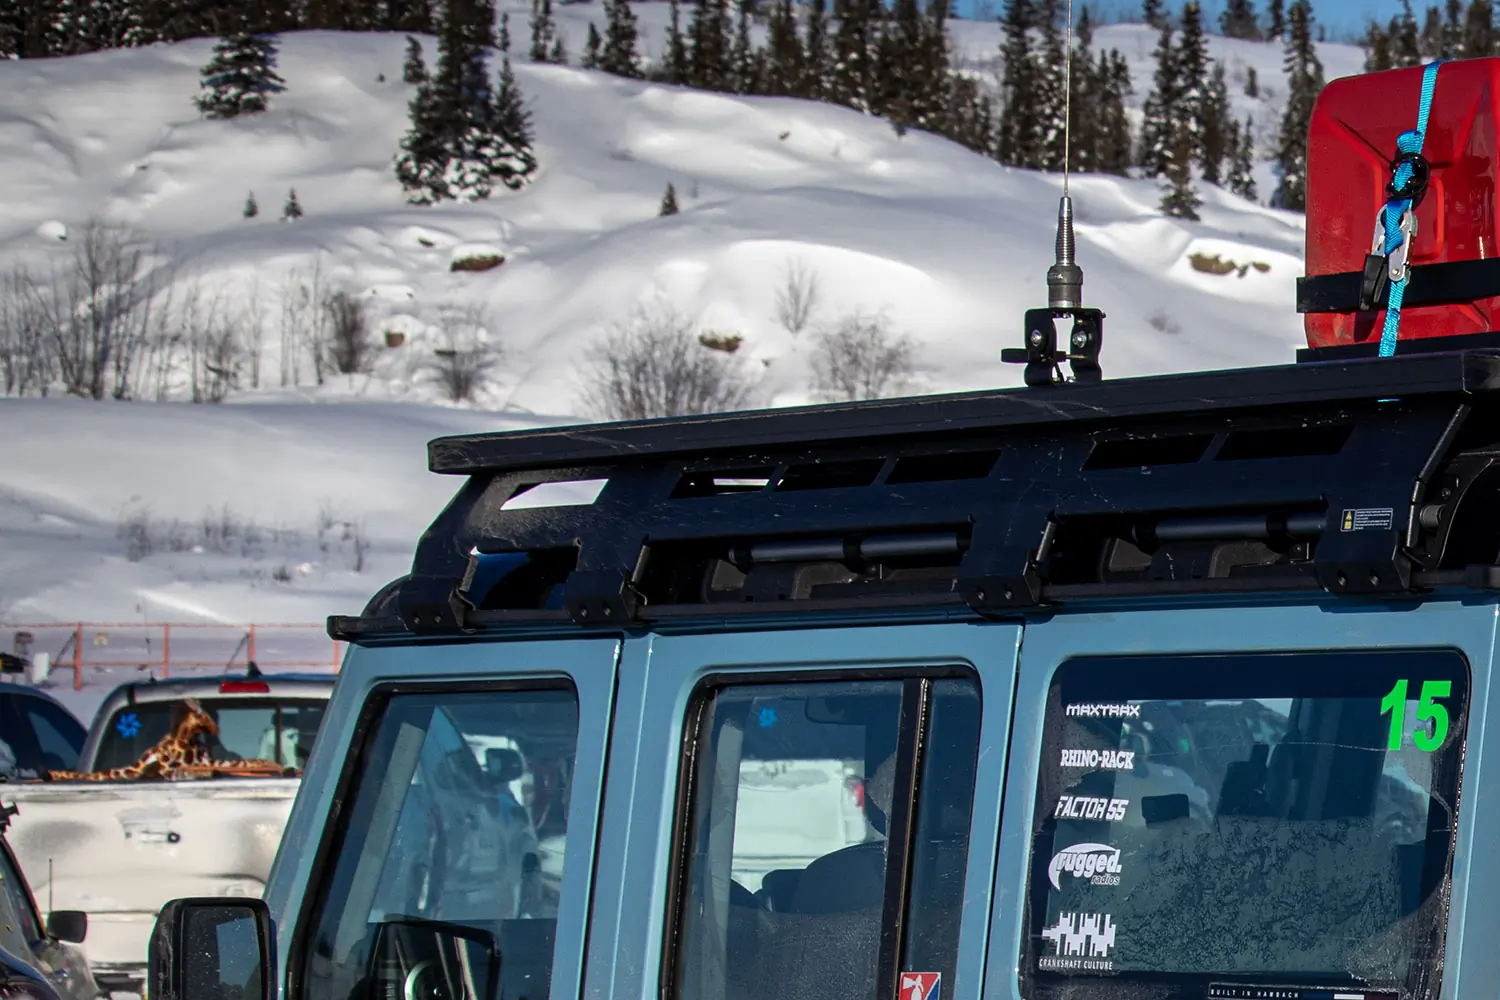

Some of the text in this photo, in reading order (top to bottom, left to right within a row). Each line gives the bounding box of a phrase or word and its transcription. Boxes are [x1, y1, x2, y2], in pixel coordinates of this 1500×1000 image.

[1066, 704, 1140, 717] MAXTRAX
[1381, 679, 1452, 752] 15
[1060, 749, 1135, 769] RHINO-RACK
[1054, 796, 1129, 820] FACTOR 55
[1091, 874, 1120, 885] radios
[1038, 958, 1113, 970] CRANKSHAFT CULTURE
[1210, 988, 1236, 996] BUILT
